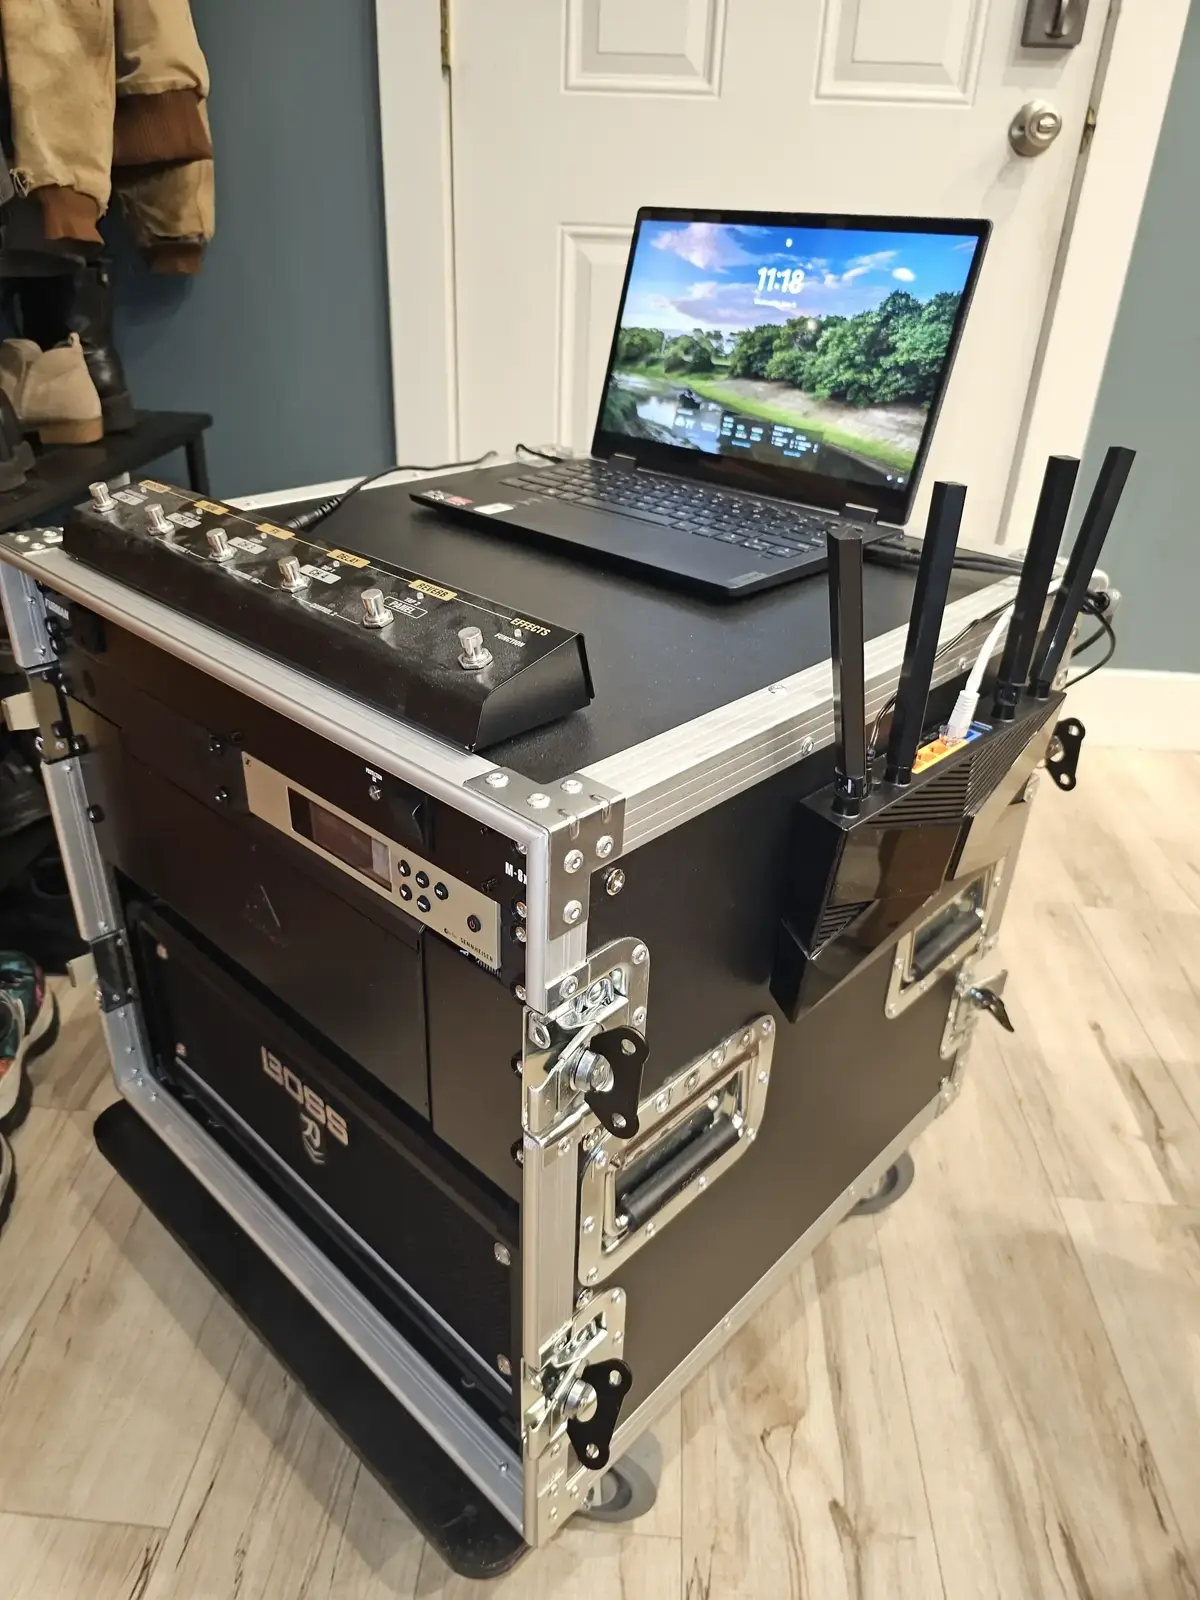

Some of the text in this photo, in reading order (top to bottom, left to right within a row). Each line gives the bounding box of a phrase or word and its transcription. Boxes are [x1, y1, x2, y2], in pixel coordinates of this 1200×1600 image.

[757, 266, 805, 294] 11:18
[336, 552, 361, 564] DELAY
[416, 582, 449, 598] REVERB
[388, 600, 416, 615] PANEL
[509, 617, 552, 637] EFFECTS
[493, 632, 527, 648] FUNCTION
[459, 936, 494, 963] SENNHEISER
[260, 1045, 349, 1147] BOSS
